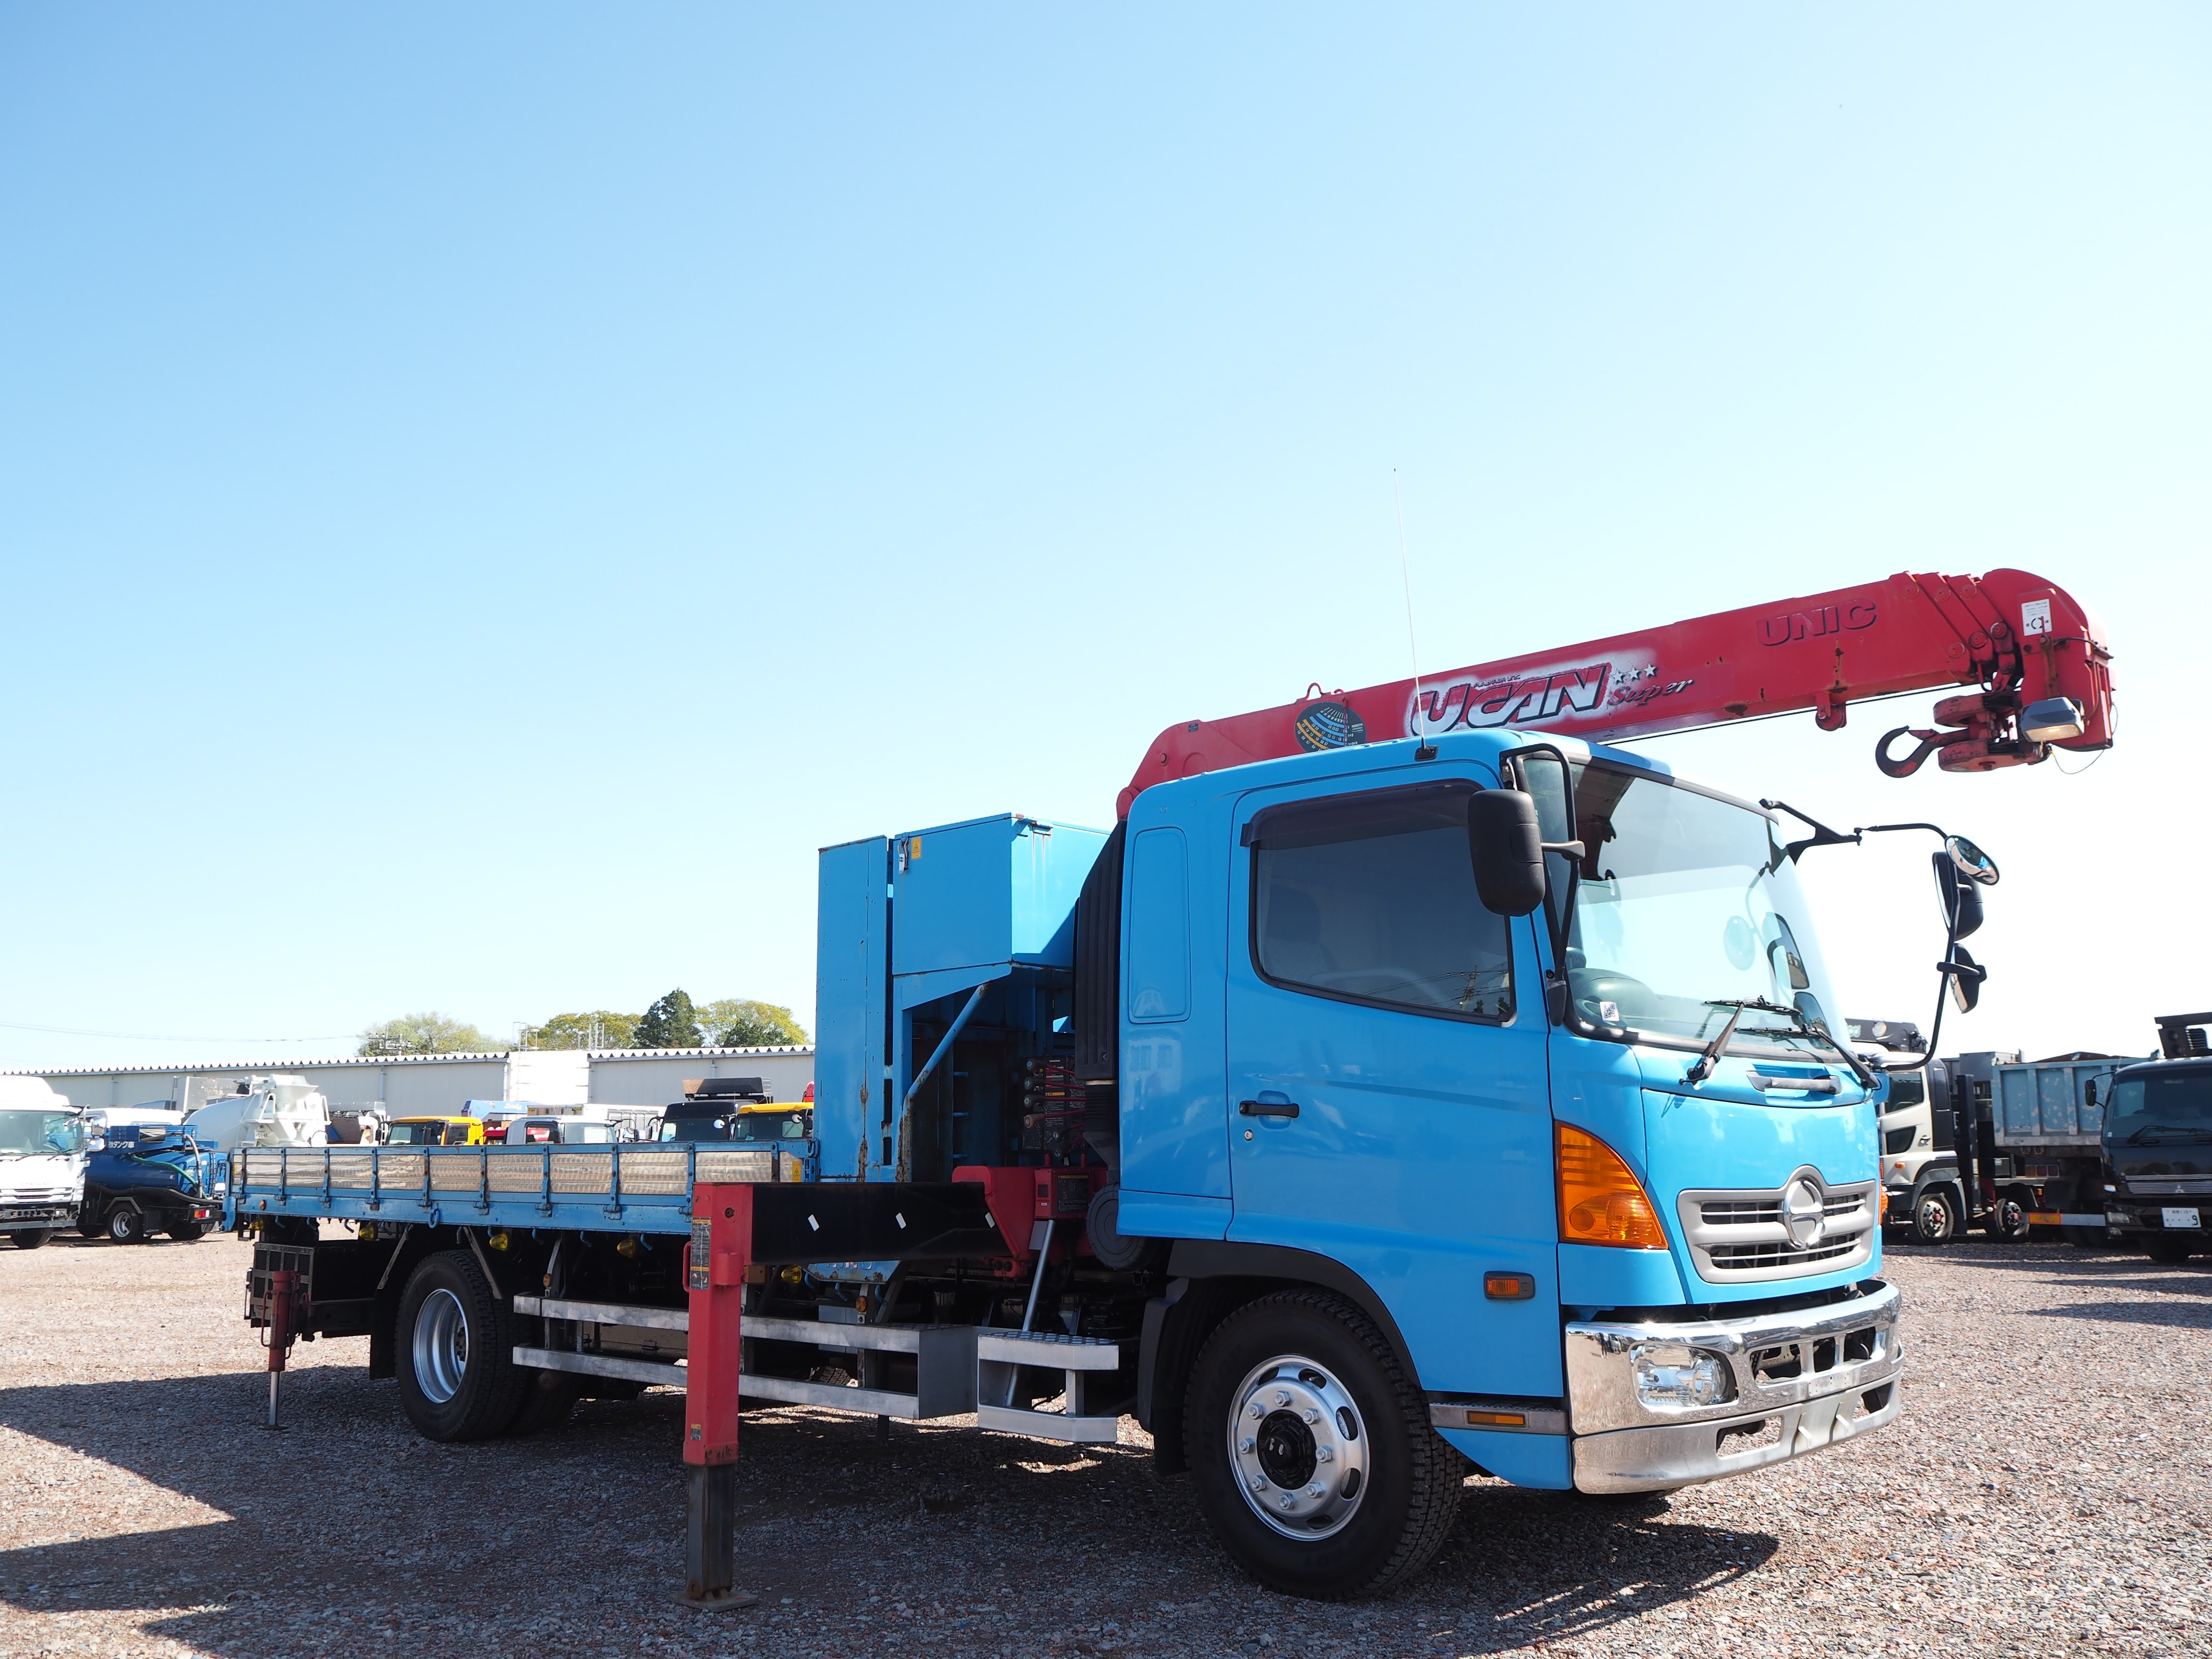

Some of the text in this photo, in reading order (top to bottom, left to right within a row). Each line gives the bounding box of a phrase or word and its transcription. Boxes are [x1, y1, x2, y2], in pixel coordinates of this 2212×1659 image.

[1756, 599, 1876, 646] UNIC
[1411, 664, 1607, 736] UCAN
[1607, 678, 1695, 706] Super
